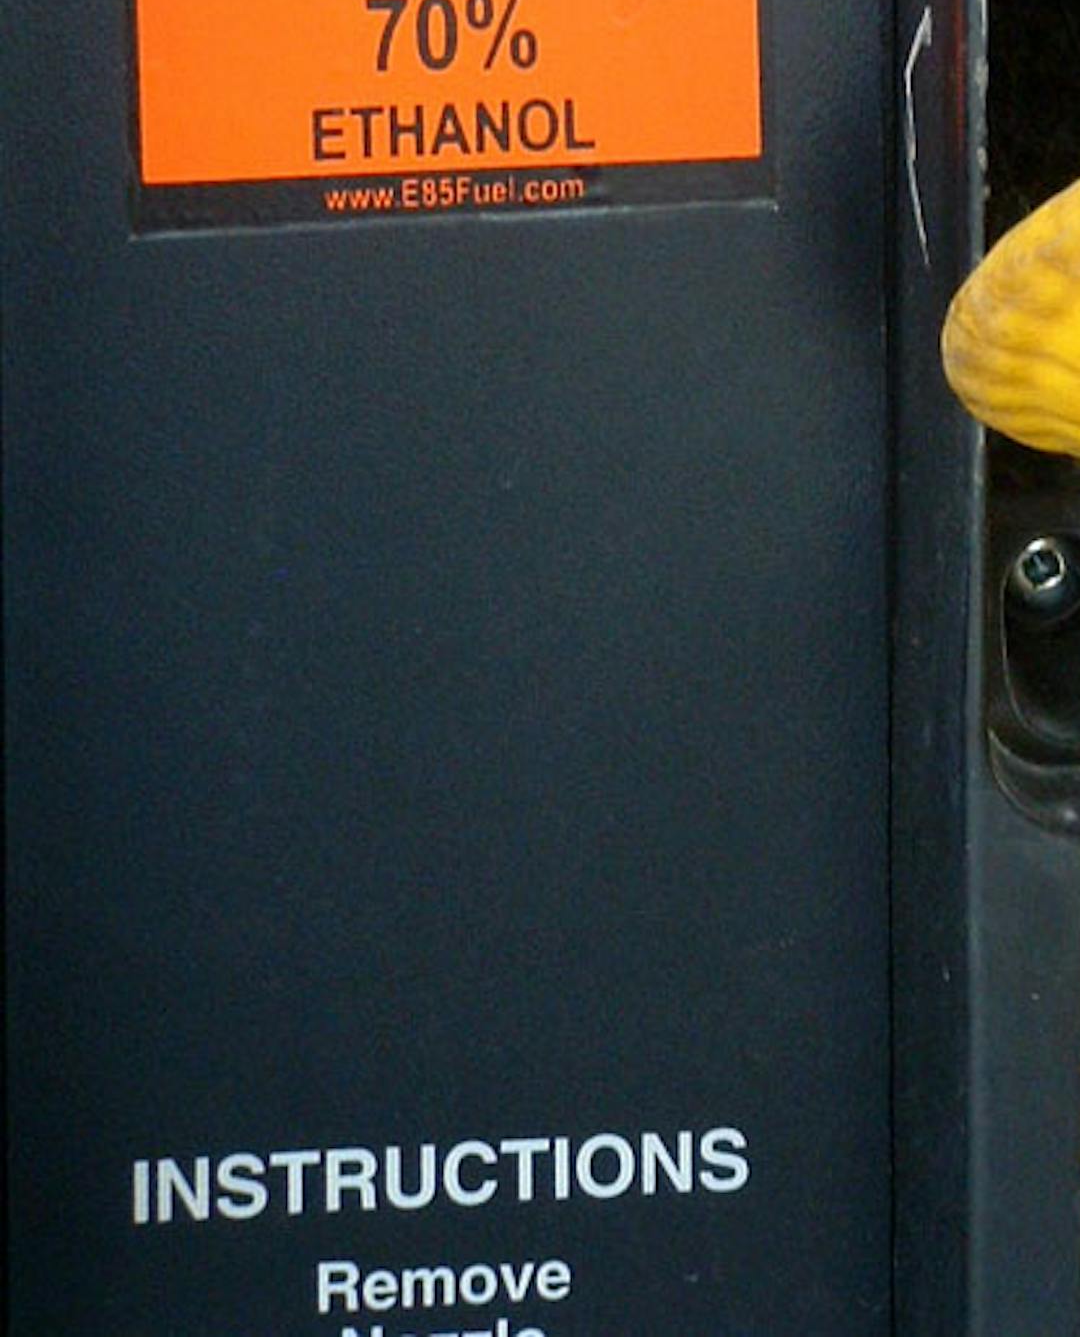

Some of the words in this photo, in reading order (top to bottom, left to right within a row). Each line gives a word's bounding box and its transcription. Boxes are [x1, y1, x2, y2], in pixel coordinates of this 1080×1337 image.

[312, 100, 596, 162] ETHANOL
[325, 175, 585, 211] www.E85Fuel.com
[132, 1127, 750, 1224] INSTRUCTIONS
[317, 1260, 572, 1314] Remove
